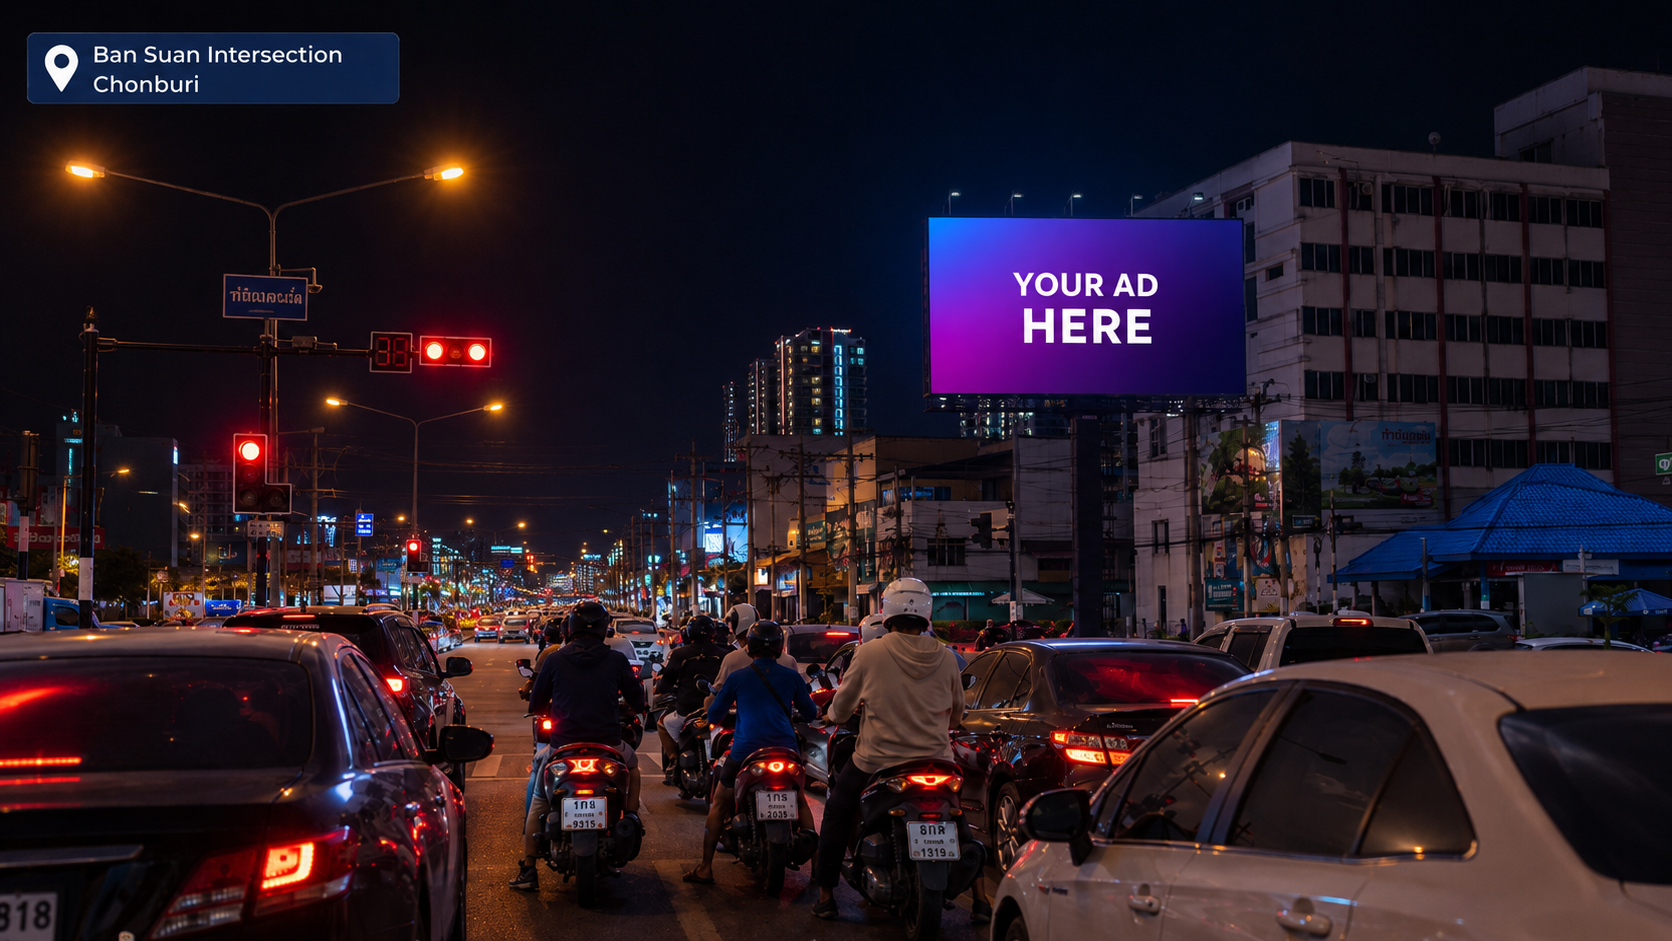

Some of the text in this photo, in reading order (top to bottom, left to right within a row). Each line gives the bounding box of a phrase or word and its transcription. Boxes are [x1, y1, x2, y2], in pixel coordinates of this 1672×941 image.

[1013, 272, 1159, 297] YOUR AD
[1023, 308, 1152, 344] HERE
[920, 847, 946, 858] 1319
